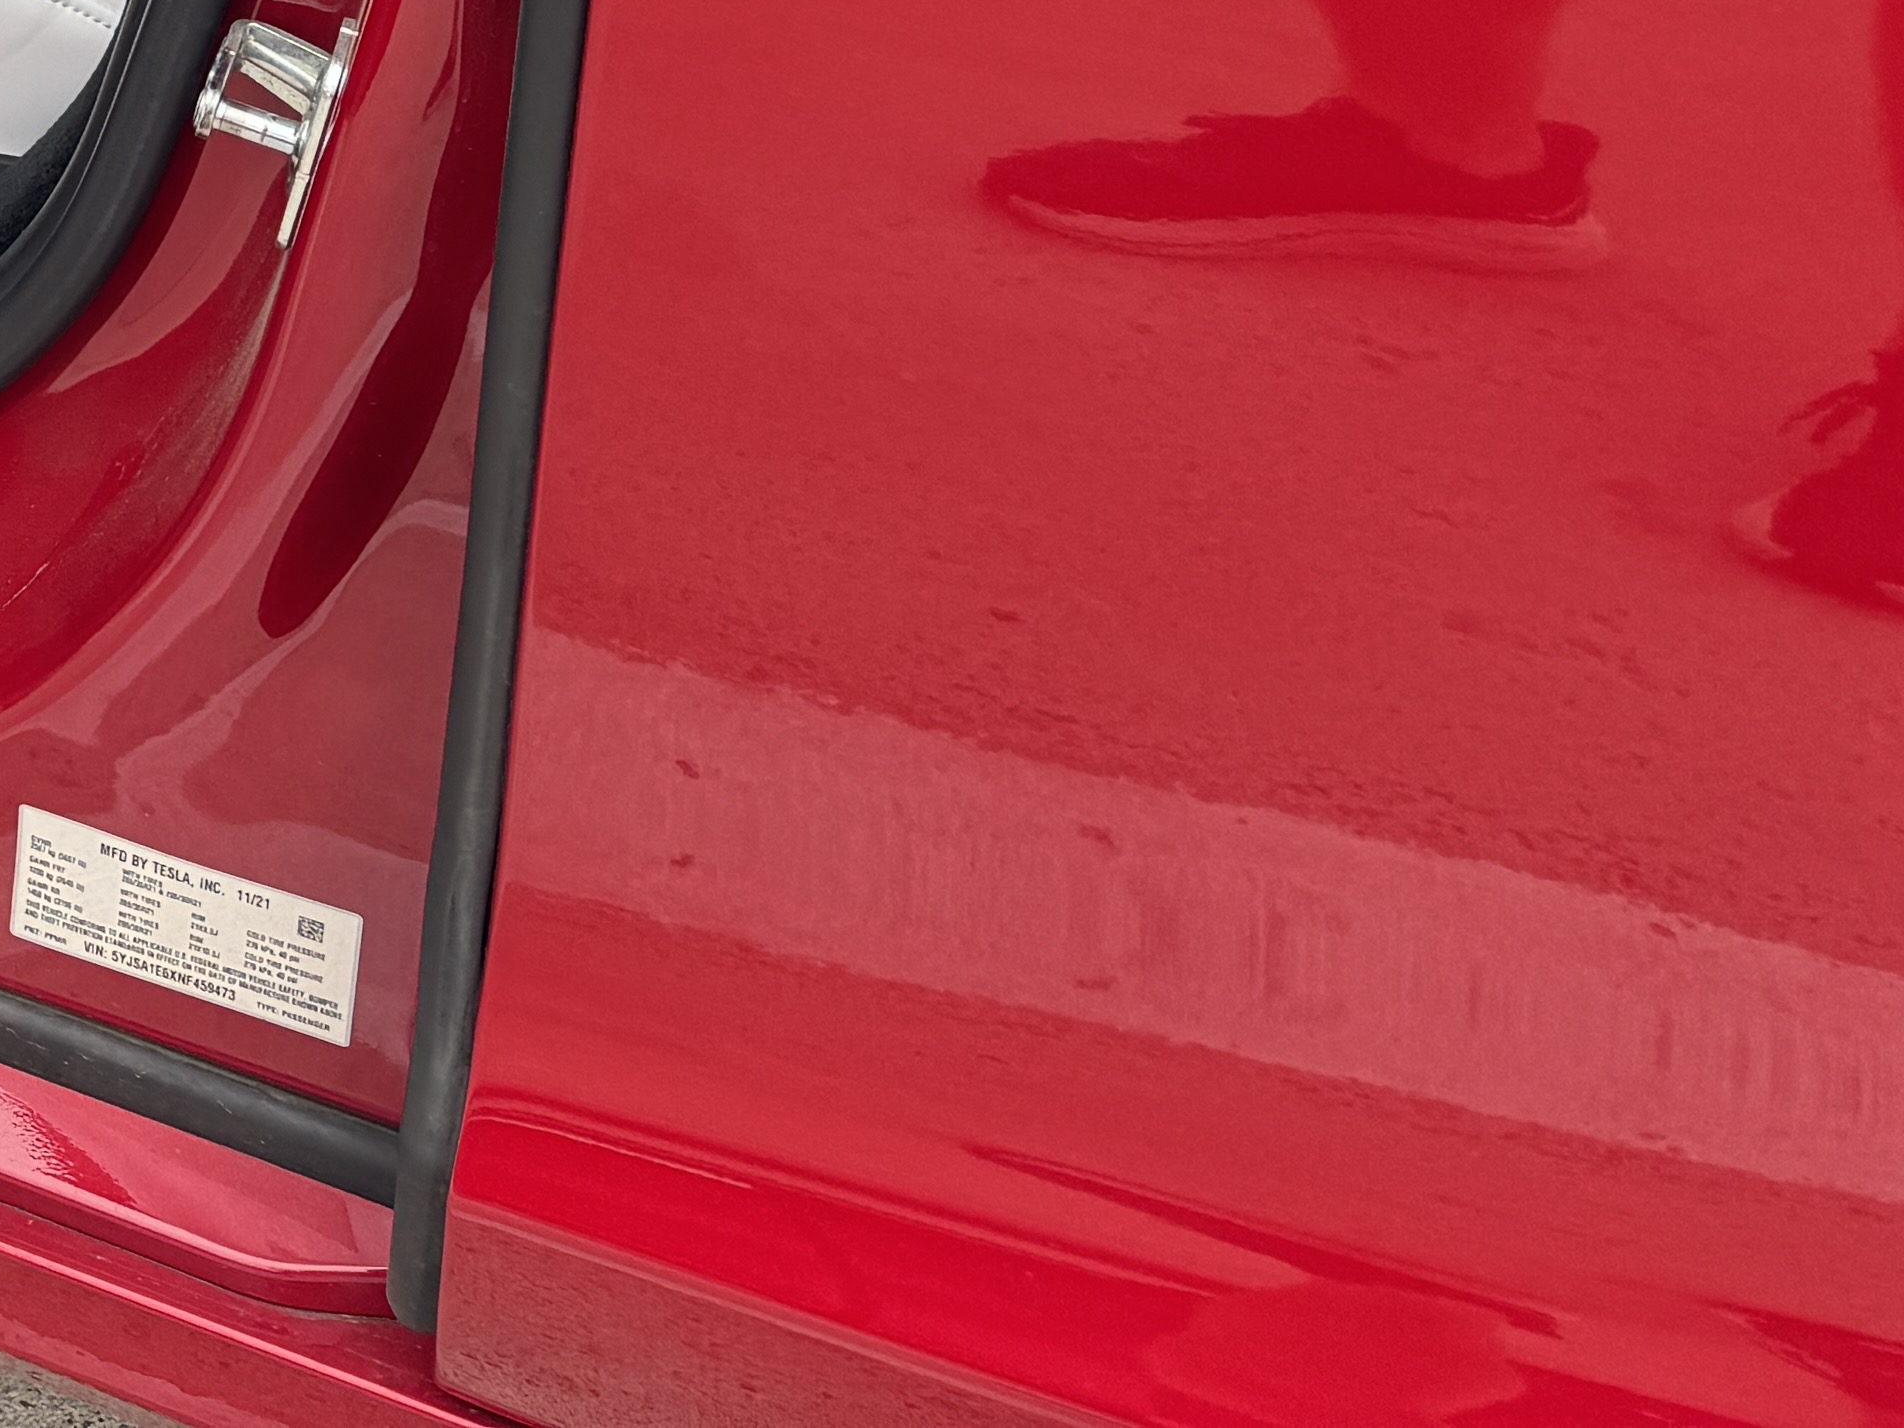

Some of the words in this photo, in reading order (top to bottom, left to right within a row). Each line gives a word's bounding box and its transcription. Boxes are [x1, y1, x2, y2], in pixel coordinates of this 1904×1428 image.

[99, 842, 127, 862] MFD
[131, 853, 148, 870] BY
[151, 860, 194, 887] TESLA,
[199, 876, 225, 895] INC.
[237, 888, 270, 910] 11/21
[83, 940, 107, 958] VIN:
